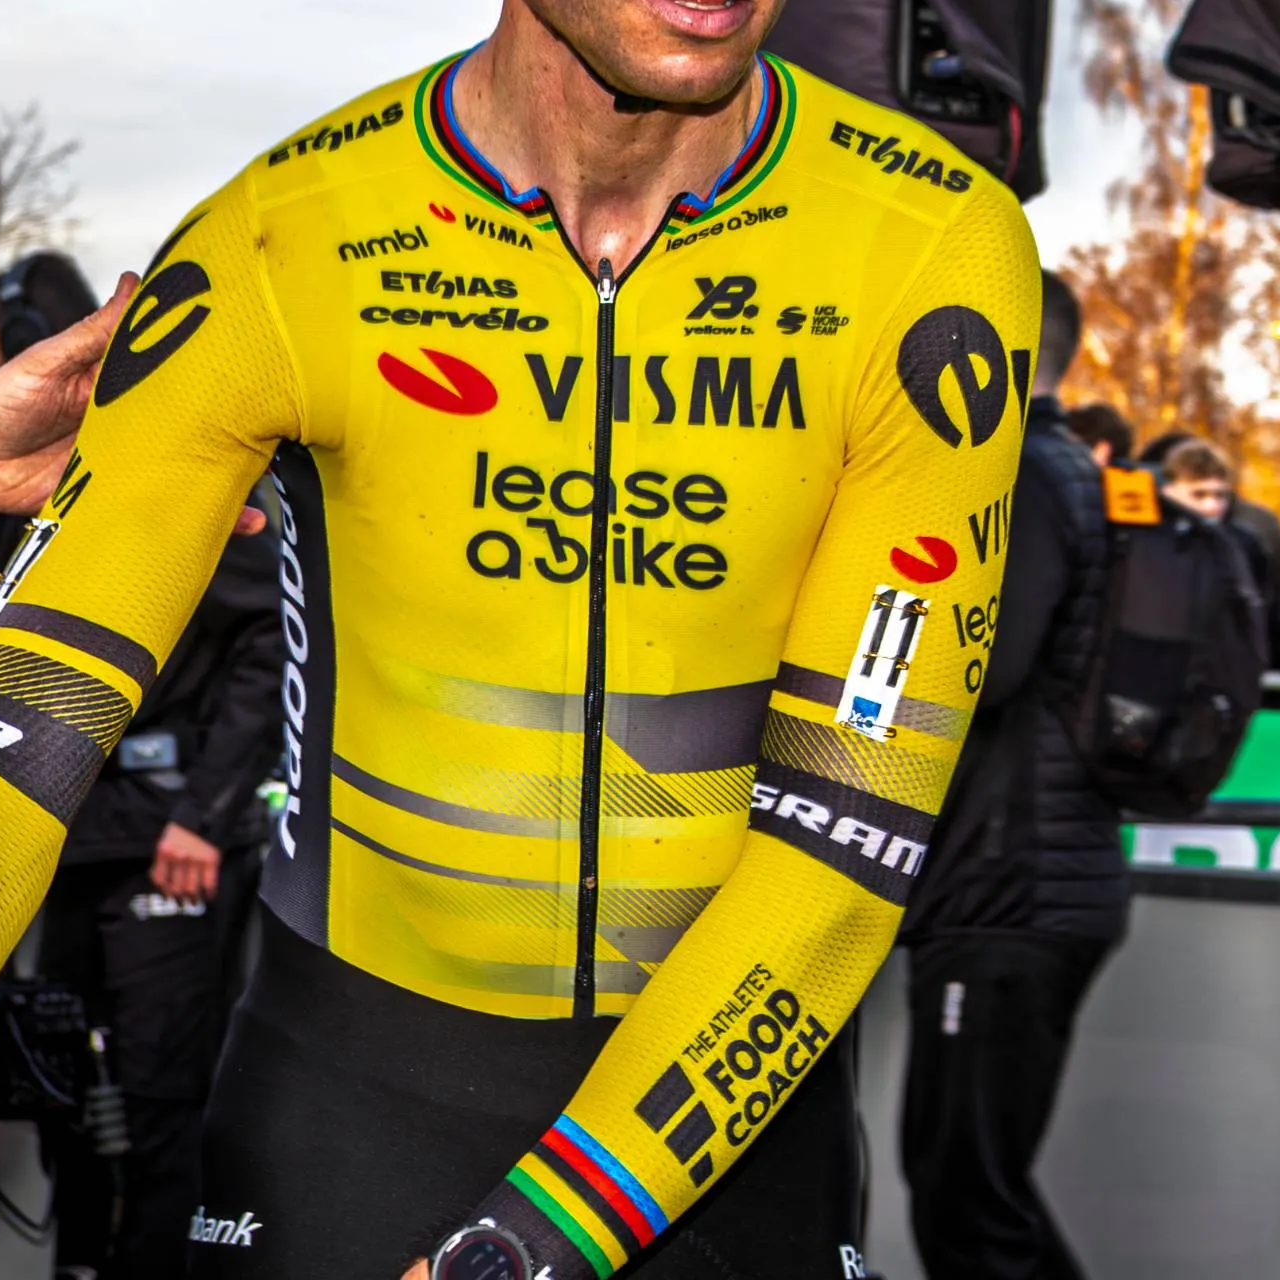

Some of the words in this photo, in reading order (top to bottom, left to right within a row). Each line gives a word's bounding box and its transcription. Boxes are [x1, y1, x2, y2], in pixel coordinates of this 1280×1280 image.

[337, 225, 430, 262] nimbl
[464, 213, 534, 252] VISMA
[665, 221, 725, 252] lease
[359, 305, 550, 333] cervélo
[811, 315, 850, 328] WORLD
[813, 305, 838, 316] UCI
[683, 324, 737, 337] yellow
[809, 325, 838, 337] TEAM
[523, 352, 807, 430] VISMA
[472, 450, 729, 524] lease
[858, 587, 927, 689] 11
[750, 781, 929, 878] SRAM
[681, 1029, 717, 1064] THE
[708, 961, 774, 1042] ATHLETE'S
[702, 988, 801, 1104] FOOD
[724, 1013, 831, 1147] COACH
